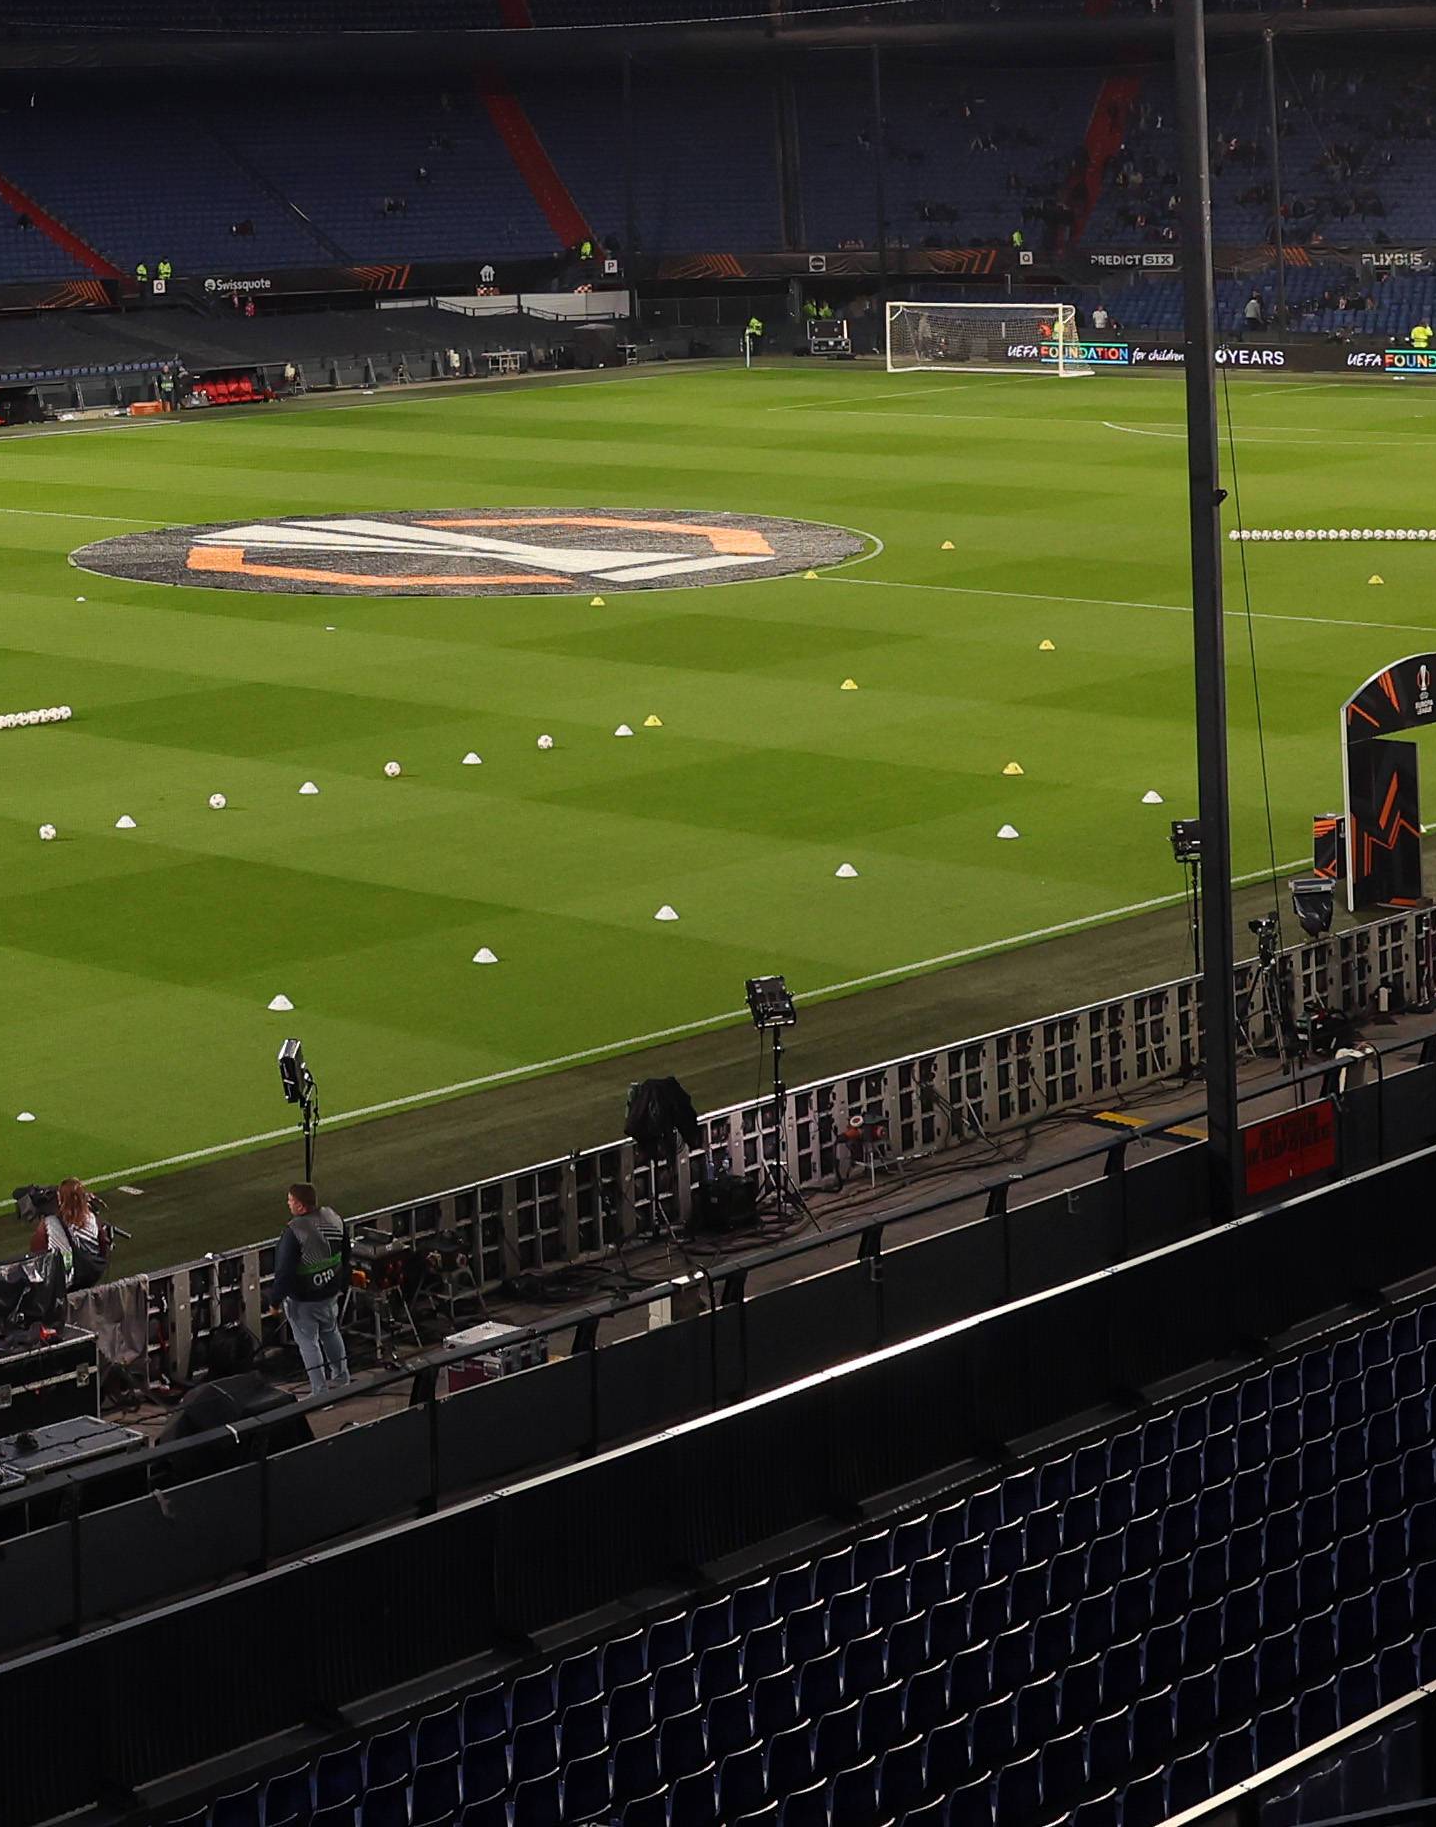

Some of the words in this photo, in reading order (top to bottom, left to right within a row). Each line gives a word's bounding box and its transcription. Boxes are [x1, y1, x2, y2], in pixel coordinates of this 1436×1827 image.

[1090, 254, 1142, 266] PREDICT
[1145, 255, 1172, 265] SIX
[216, 277, 272, 293] Swissquote
[1007, 344, 1039, 359] UEFA
[1132, 347, 1147, 365] for
[1346, 352, 1382, 367] UEFA
